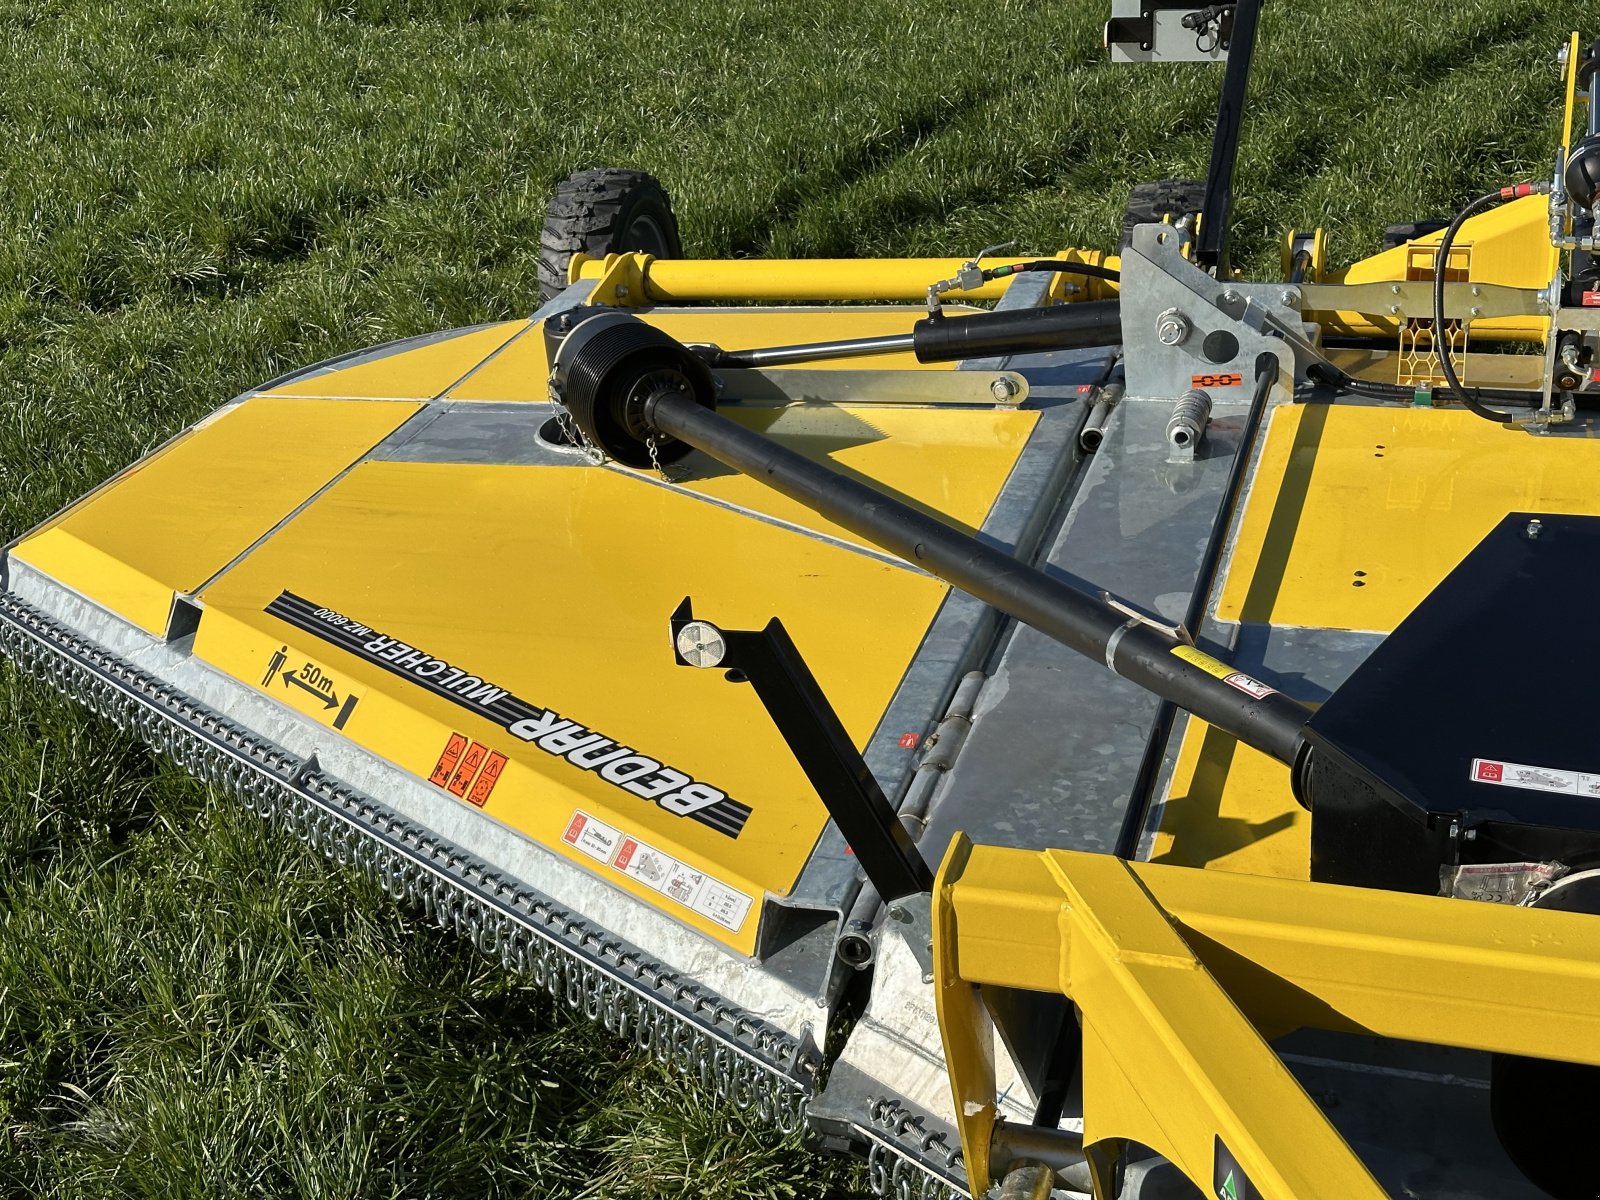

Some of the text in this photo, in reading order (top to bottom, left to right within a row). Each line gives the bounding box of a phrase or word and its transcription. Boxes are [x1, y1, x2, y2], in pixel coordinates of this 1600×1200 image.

[313, 608, 725, 816] BEDNAR MULCHER MZ 6000
[470, 795, 483, 804] STOP
